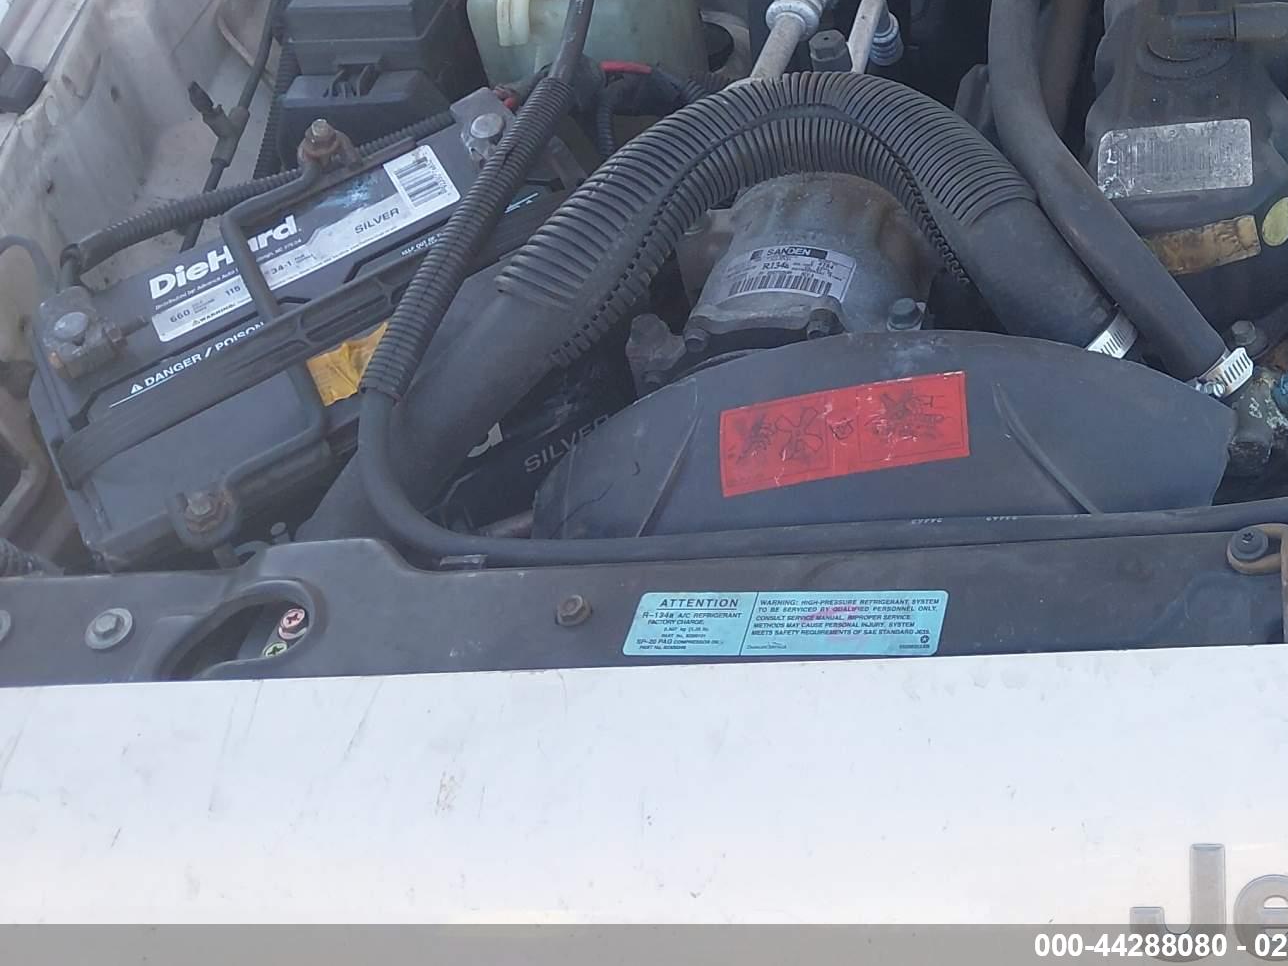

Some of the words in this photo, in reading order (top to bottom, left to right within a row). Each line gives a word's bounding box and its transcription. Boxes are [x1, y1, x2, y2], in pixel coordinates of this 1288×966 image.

[354, 207, 400, 234] SILVER
[767, 247, 811, 256] SANDEN
[170, 309, 191, 323] 660
[144, 353, 202, 386] DANGER
[659, 598, 739, 608] ATTENTION
